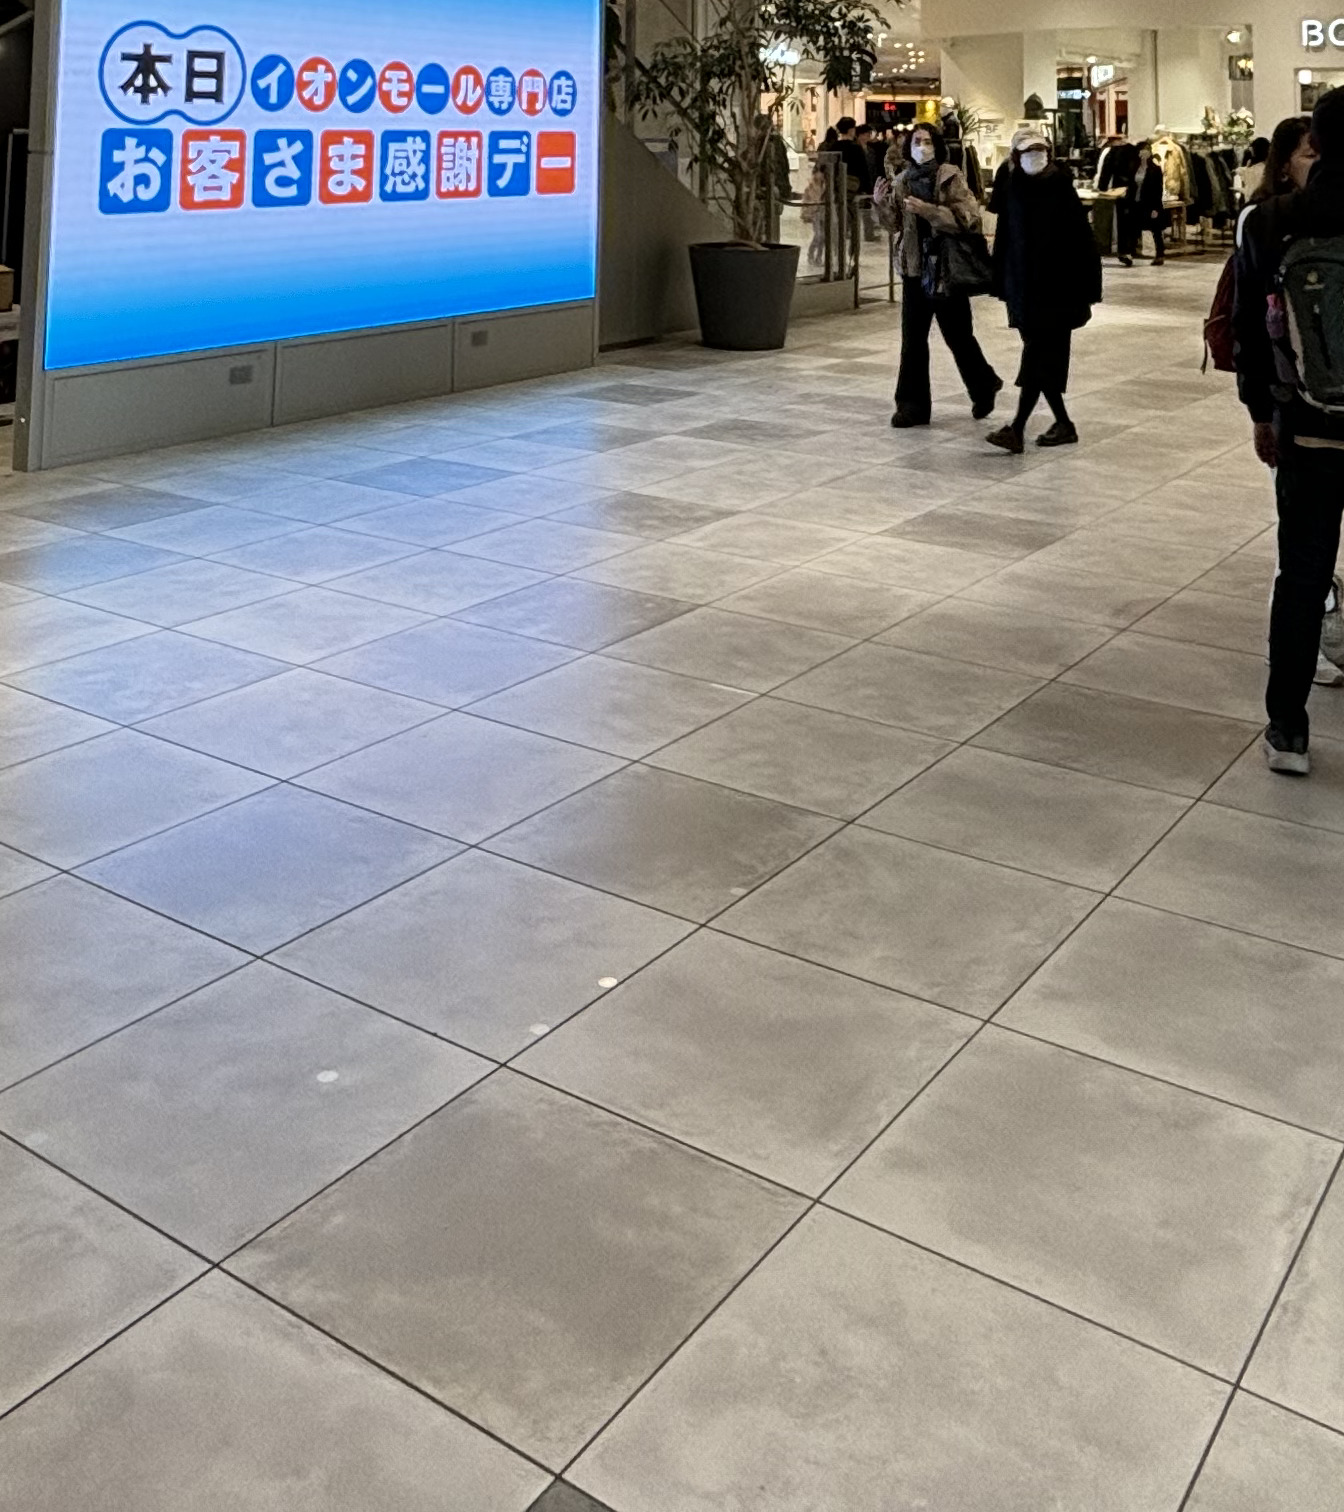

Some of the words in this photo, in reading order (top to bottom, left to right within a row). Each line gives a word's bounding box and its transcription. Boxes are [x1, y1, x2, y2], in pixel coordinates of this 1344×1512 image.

[118, 41, 227, 106] 本日
[256, 66, 574, 111] イオンモール専門店
[104, 132, 574, 206] お客さま感謝デー
